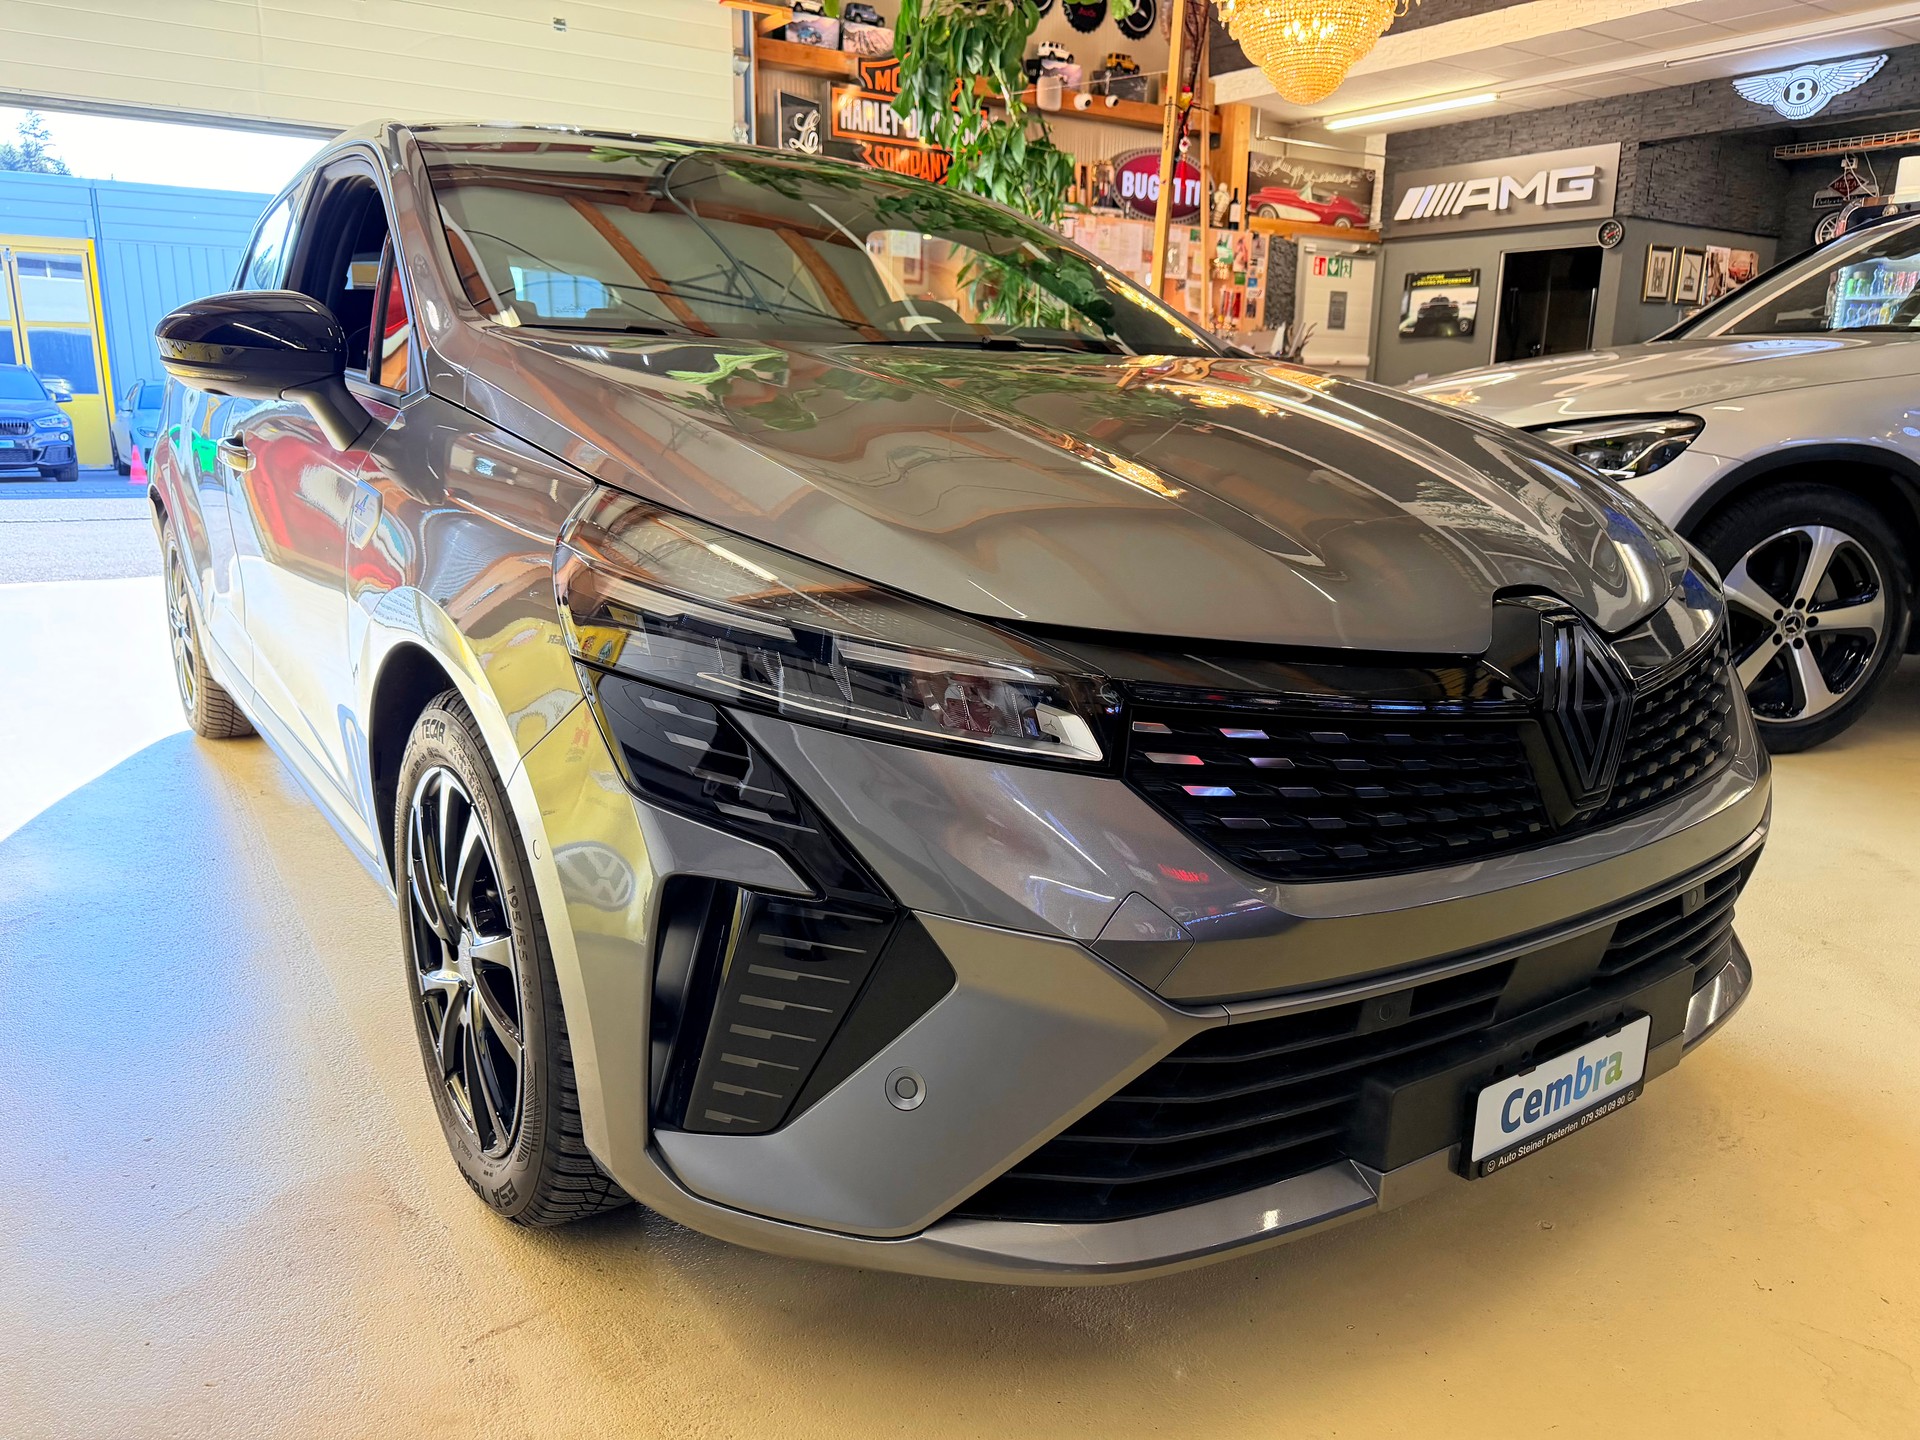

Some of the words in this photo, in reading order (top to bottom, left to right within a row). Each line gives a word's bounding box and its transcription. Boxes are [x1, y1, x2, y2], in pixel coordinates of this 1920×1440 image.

[1121, 170, 1201, 206] BUGTTI
[1501, 1051, 1623, 1134] Cembra
[1498, 1151, 1517, 1167] Auto
[1518, 1137, 1546, 1158] Steiner
[1580, 1112, 1594, 1126] 079
